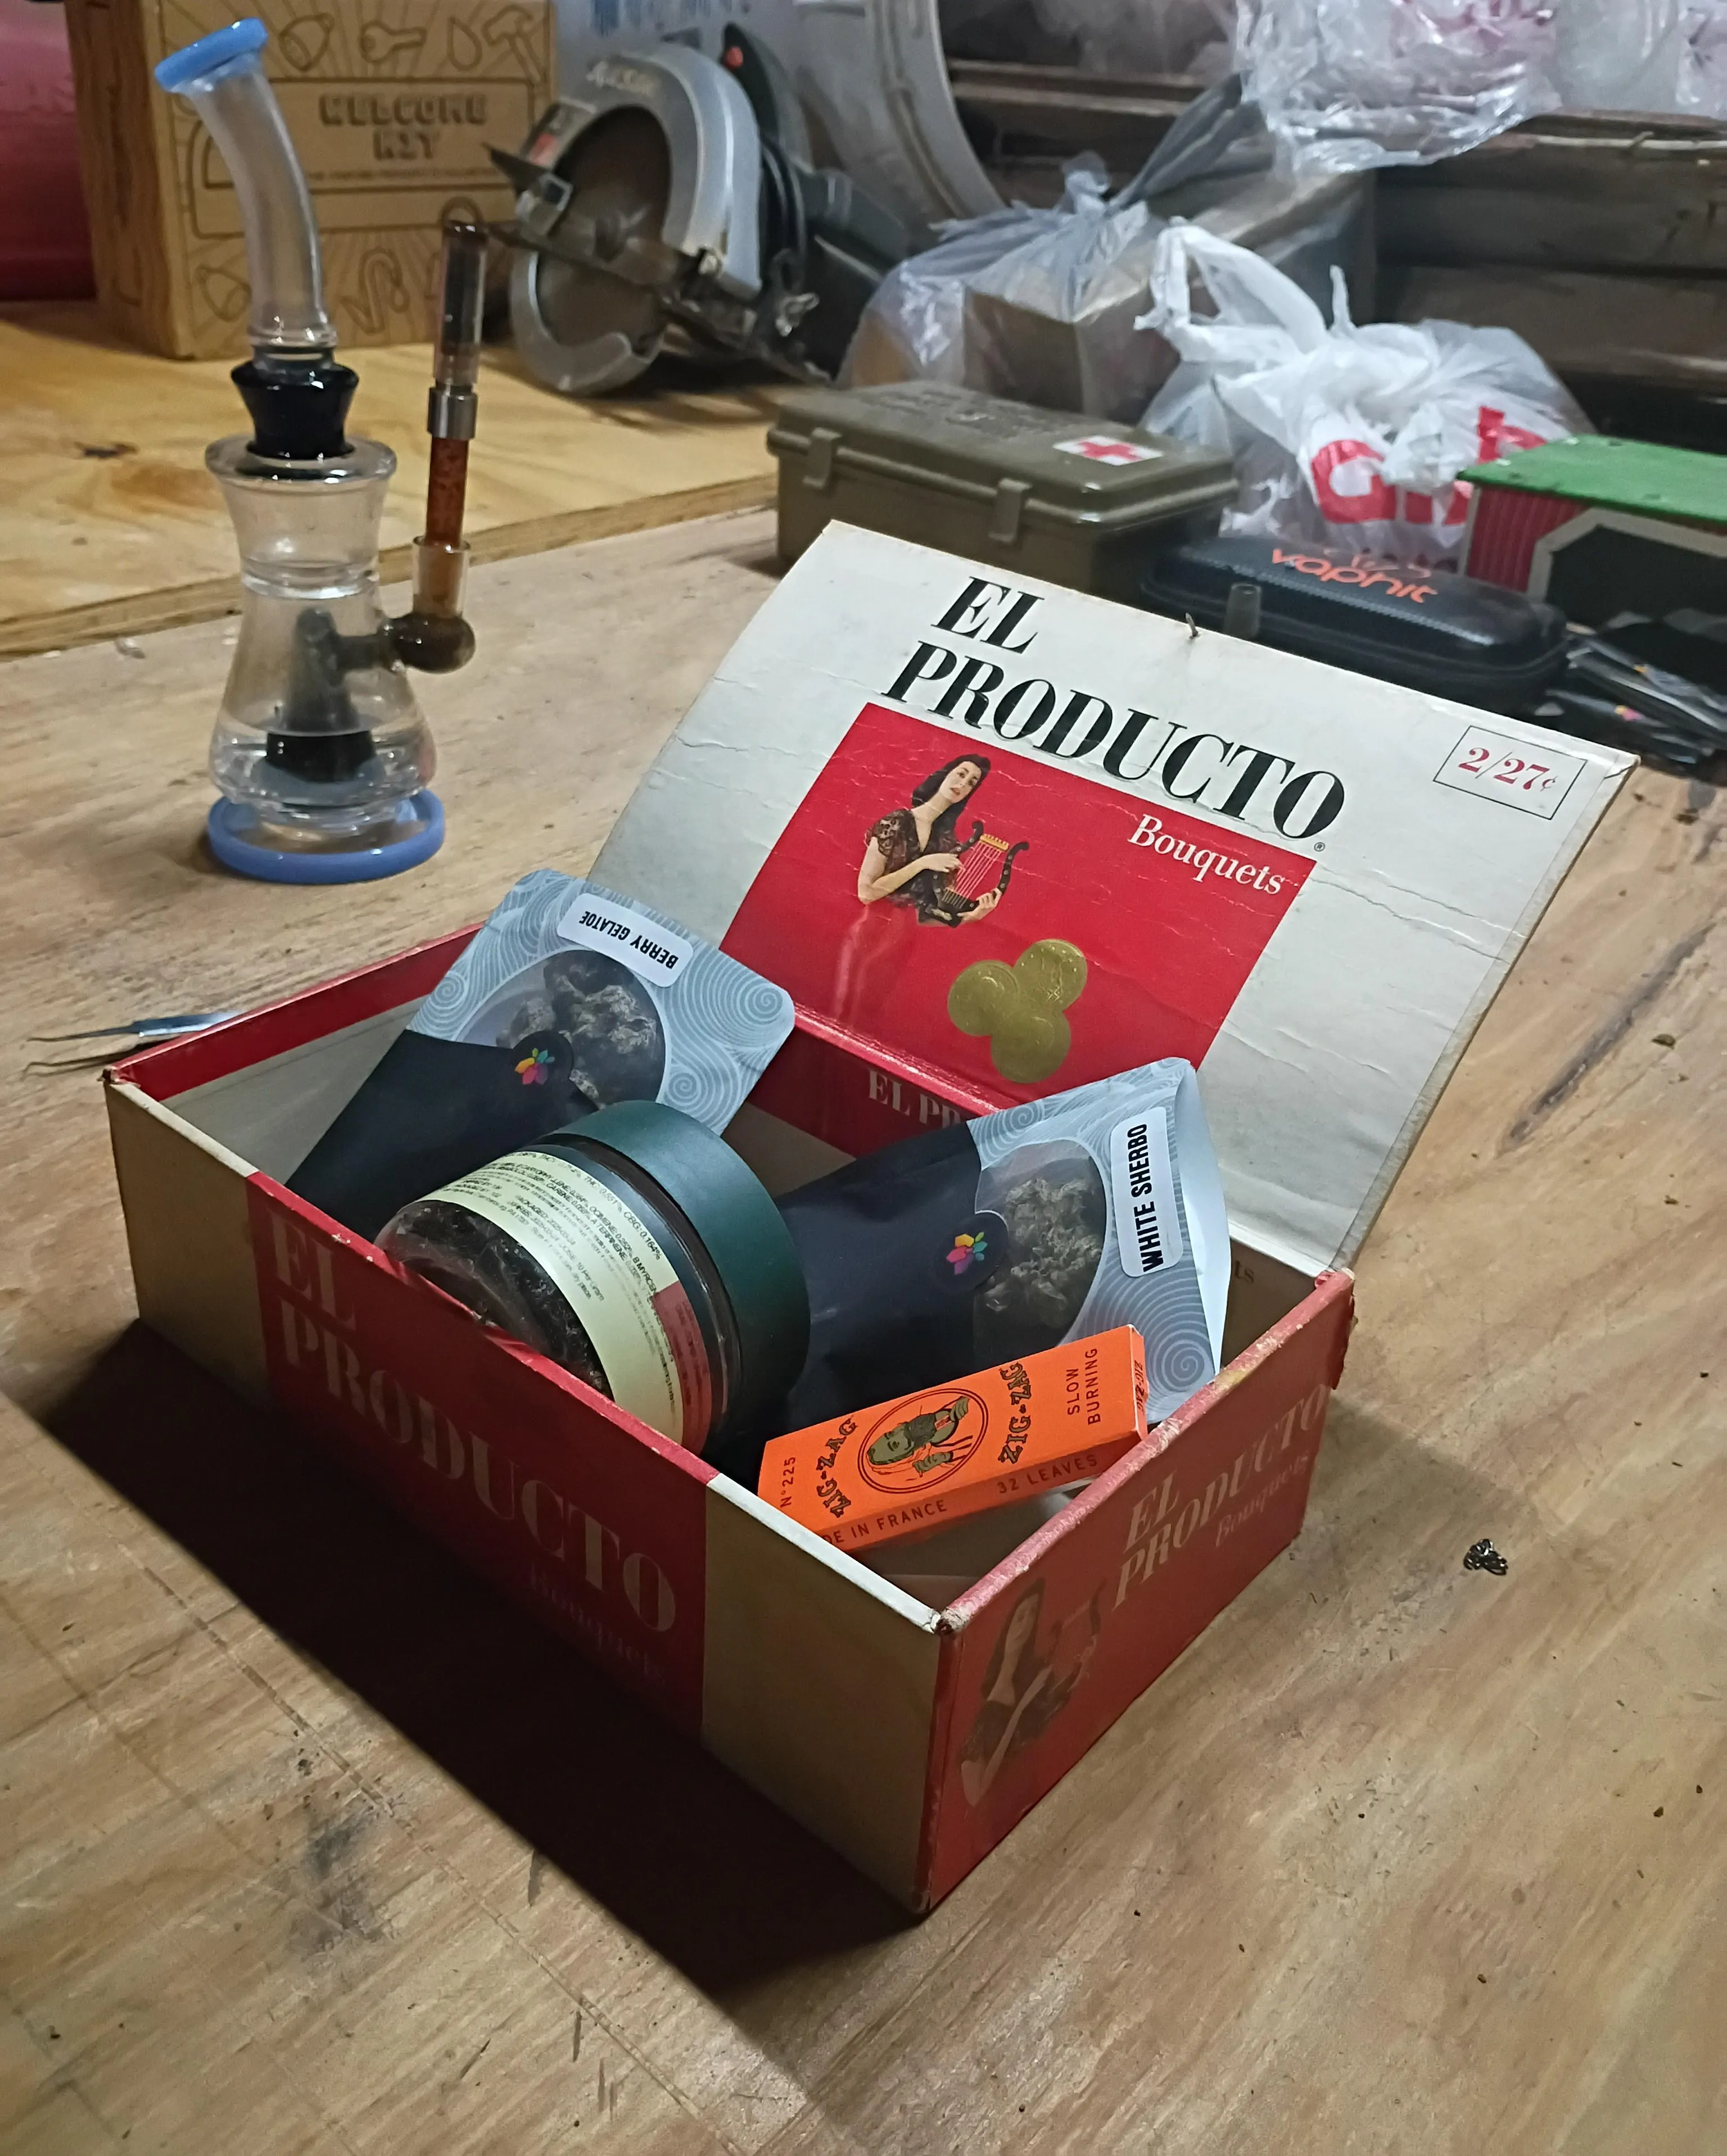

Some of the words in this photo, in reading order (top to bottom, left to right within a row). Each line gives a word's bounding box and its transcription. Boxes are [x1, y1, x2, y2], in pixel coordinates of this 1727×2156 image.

[931, 576, 1045, 654] EL
[881, 640, 1345, 839] PRODUCTO
[1458, 747, 1558, 791] 2/27¢
[1127, 814, 1285, 895] Bouquets
[578, 911, 631, 940] GELATOE
[630, 935, 679, 970] BERRY
[869, 1068, 910, 1117] EL
[1127, 1124, 1152, 1198] SHERBO
[266, 1207, 356, 1332] EL
[623, 1211, 643, 1232] CBG:
[640, 1231, 662, 1260] 0.164%
[1134, 1201, 1164, 1272] WHITE
[998, 1362, 1032, 1464] ZIG-ZAG
[1066, 1368, 1080, 1415] SLOW
[1085, 1348, 1101, 1425] BURNING
[277, 1293, 676, 1632] PRODUCTO
[816, 1414, 859, 1518] ZIG-ZAG
[997, 1479, 1019, 1494] 32
[1027, 1453, 1098, 1485] LEAVES
[1111, 1384, 1331, 1612] PRODUCTO
[851, 1523, 870, 1538] IN
[876, 1498, 948, 1530] FRANCE
[1123, 1469, 1181, 1554] EL
